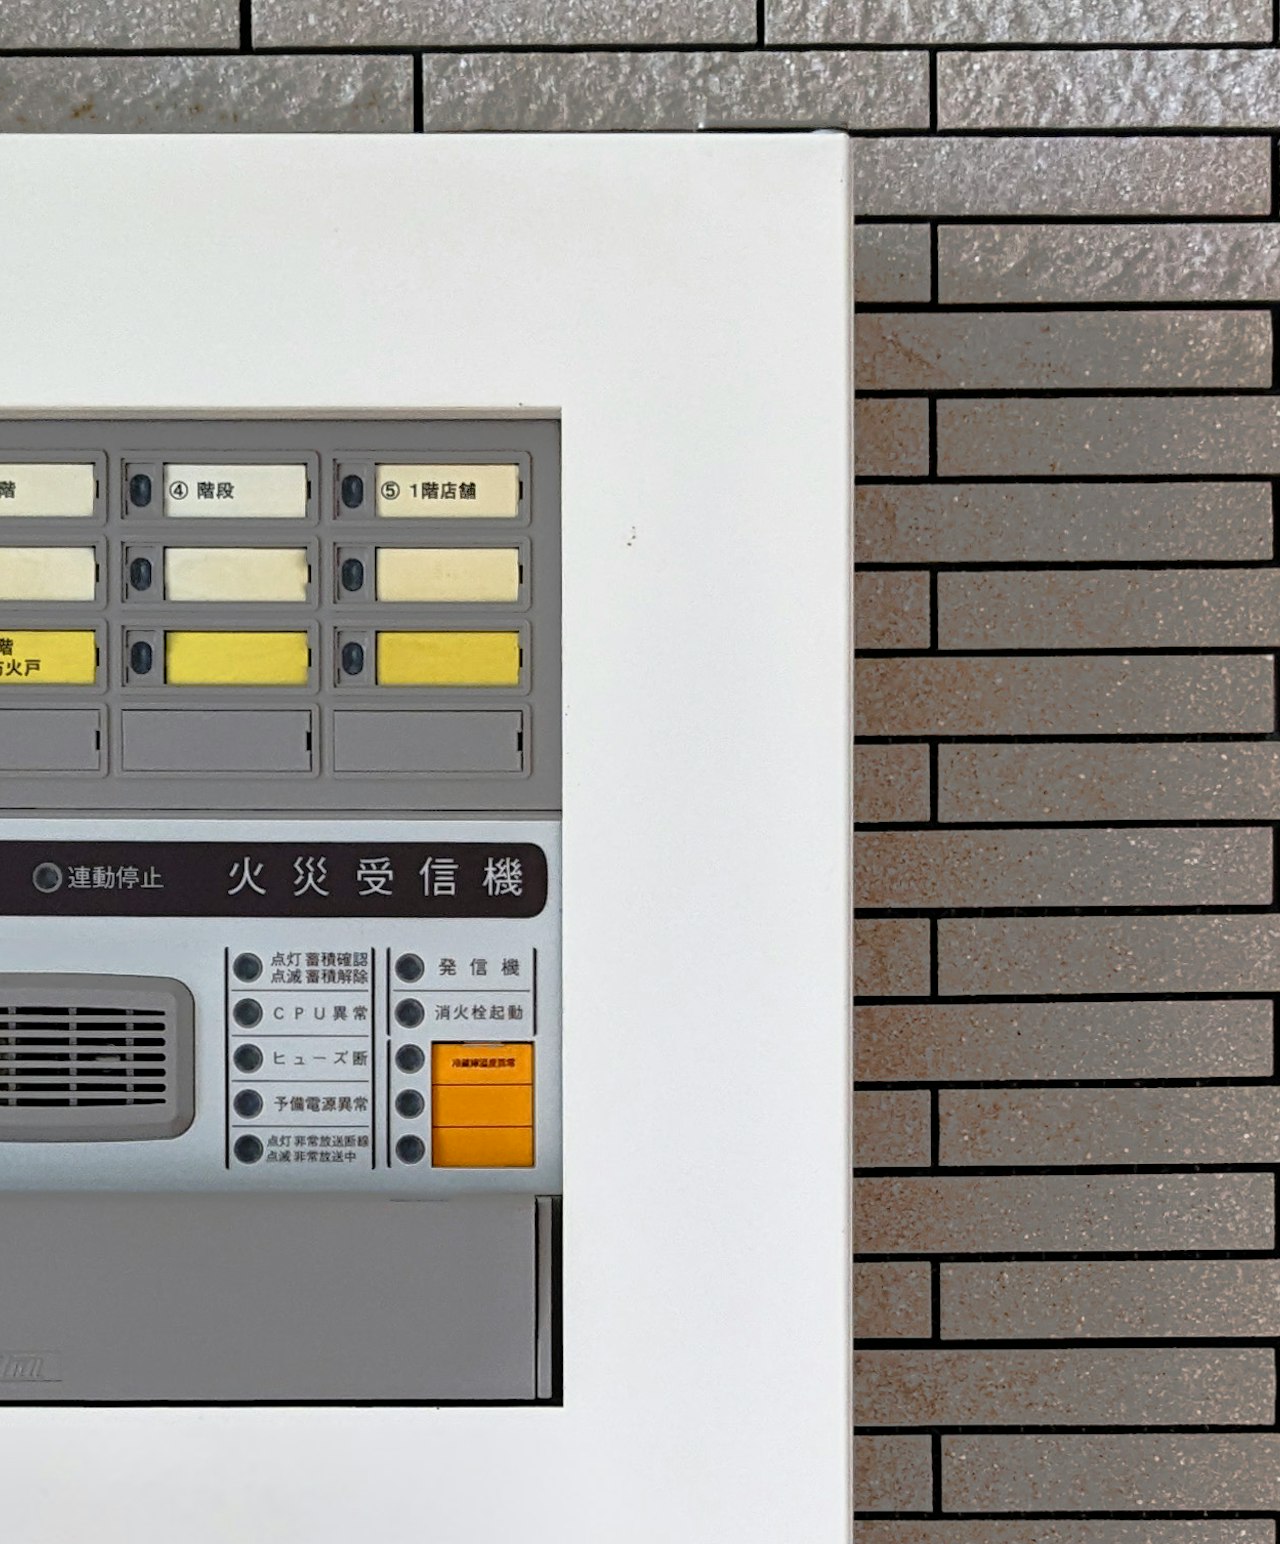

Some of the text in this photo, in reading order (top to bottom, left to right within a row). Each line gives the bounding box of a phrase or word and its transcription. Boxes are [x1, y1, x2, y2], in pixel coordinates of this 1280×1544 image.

[196, 481, 235, 500] 階段
[409, 481, 477, 500] 1階店舗
[67, 865, 165, 889] 連動停止
[227, 856, 523, 897] 火災受信機
[270, 951, 369, 968] 点灯 蓄積確認
[438, 957, 520, 977] 発信機
[270, 968, 369, 985] 点滅 蓄積解除
[434, 1004, 524, 1021] 消火栓起動
[273, 1050, 369, 1067] ヒューズ断
[274, 1095, 369, 1113] 予備電源異常
[266, 1134, 292, 1148] 点灯
[266, 1150, 357, 1163] 点滅 非常放送中
